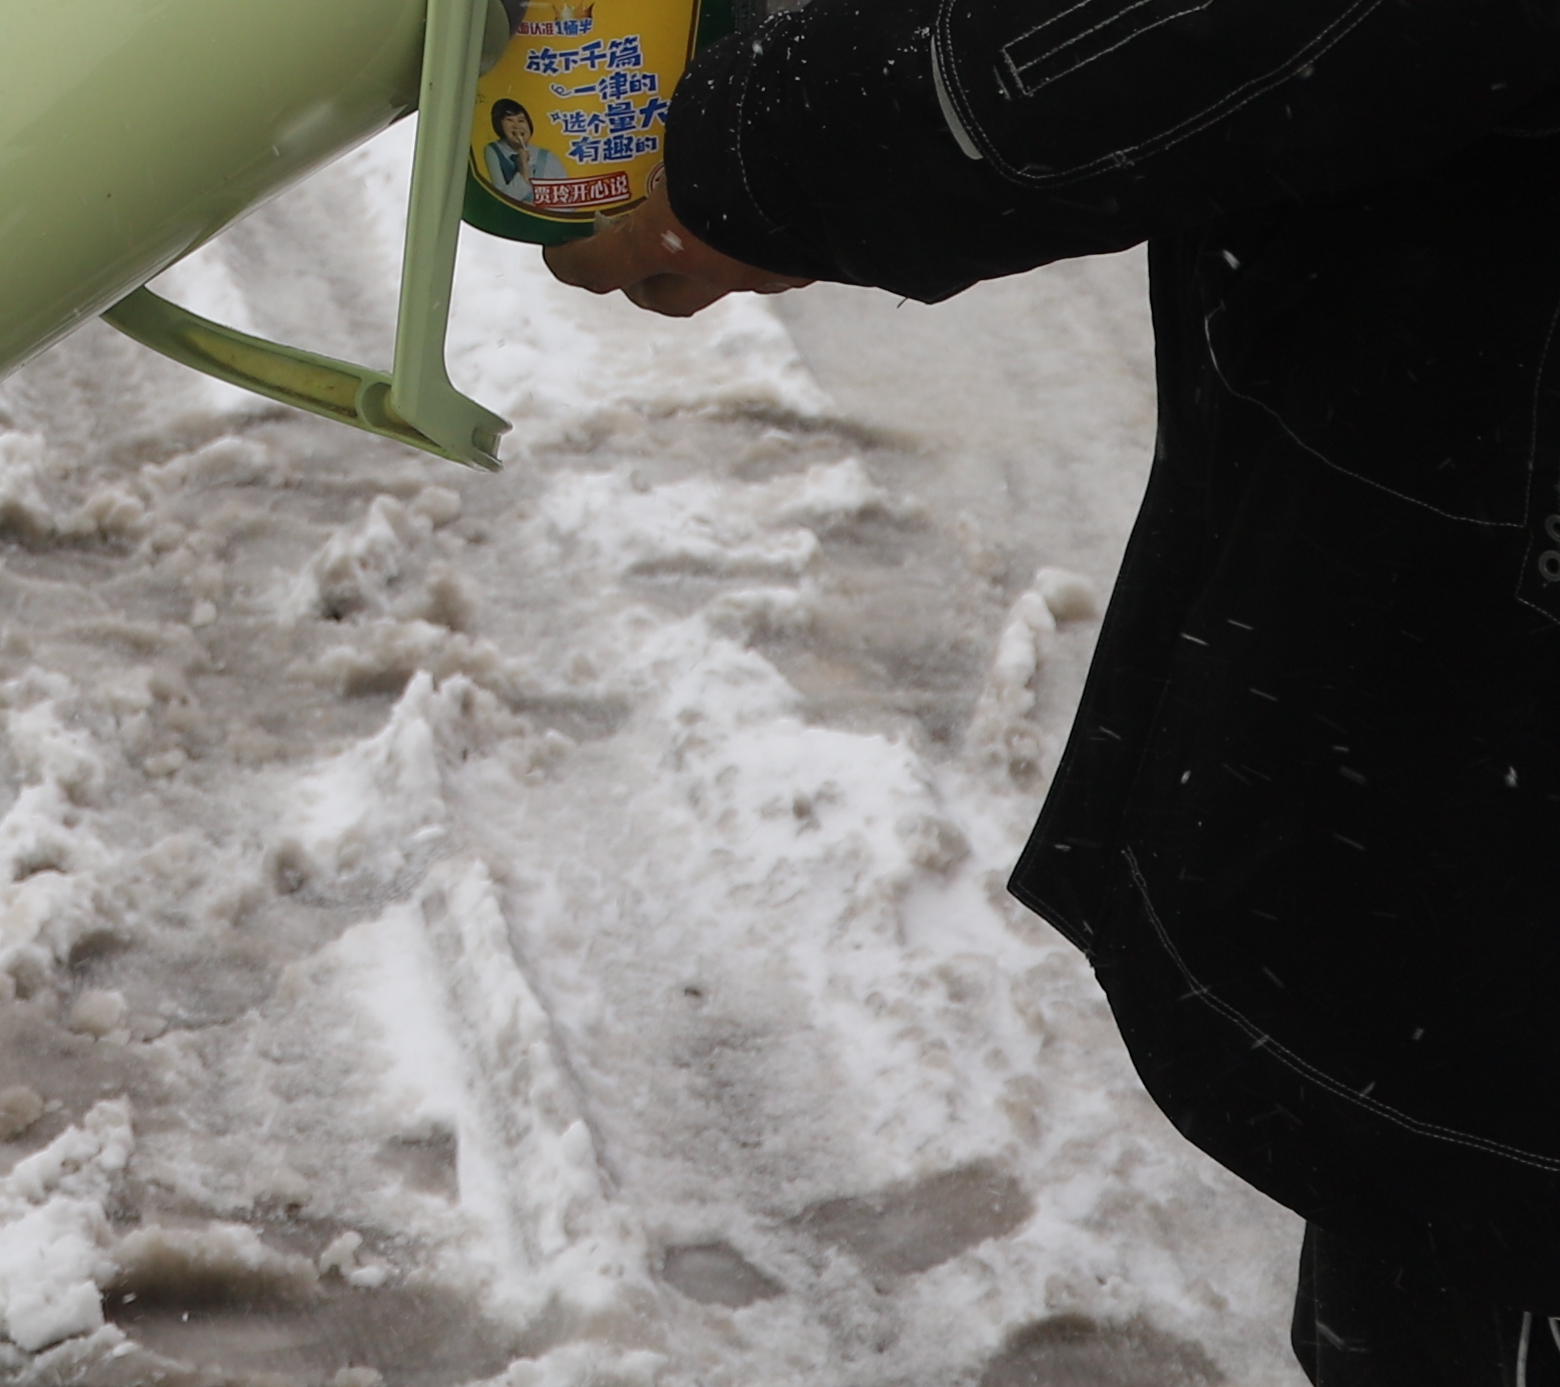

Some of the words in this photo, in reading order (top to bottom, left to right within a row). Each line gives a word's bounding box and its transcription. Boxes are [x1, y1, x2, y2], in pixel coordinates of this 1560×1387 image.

[526, 36, 641, 73] 放下千篇
[574, 72, 657, 99] 一律的
[569, 135, 657, 161] 有趣的
[534, 177, 629, 204] 贾玲开心说
